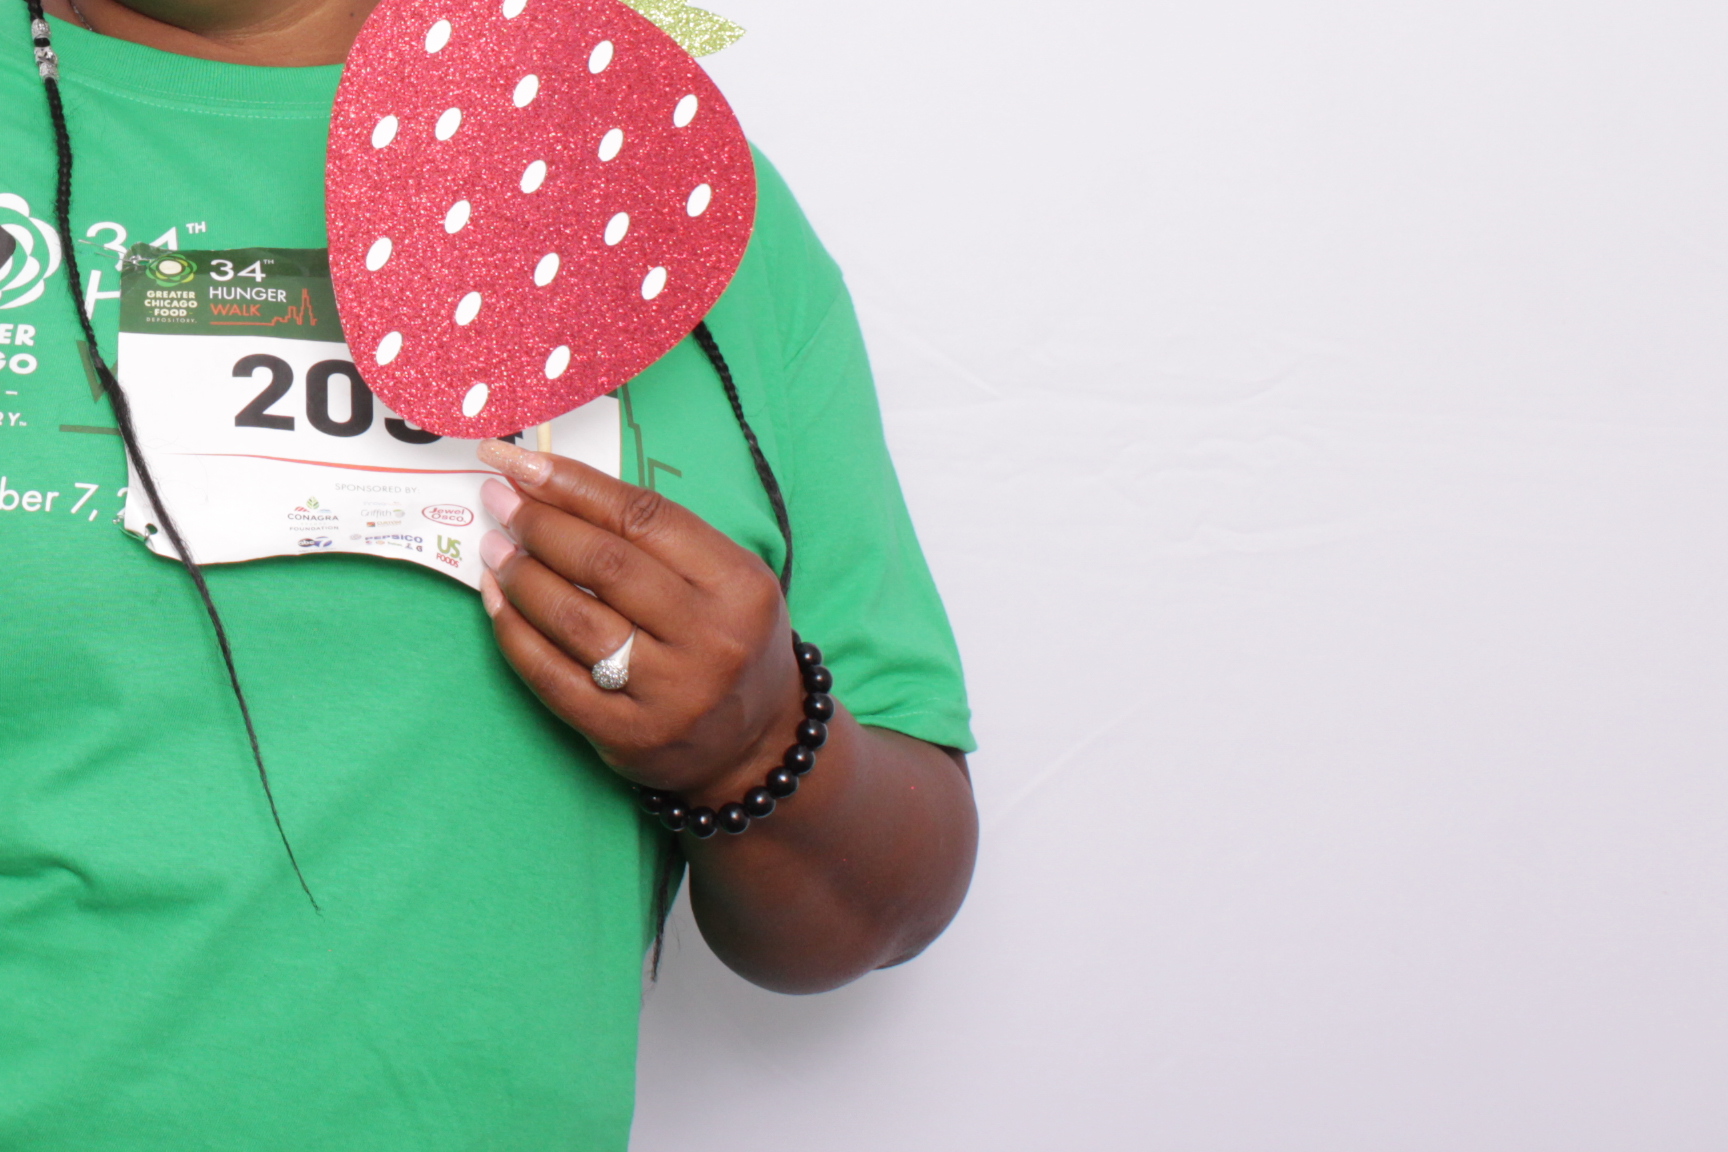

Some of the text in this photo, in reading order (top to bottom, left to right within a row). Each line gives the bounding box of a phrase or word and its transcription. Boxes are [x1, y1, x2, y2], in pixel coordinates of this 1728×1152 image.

[146, 290, 196, 299] GREATER
[209, 286, 287, 303] HUNGER
[144, 299, 198, 308] CHICAGO
[210, 303, 261, 316] WALK
[334, 483, 402, 494] SPONSORED
[70, 482, 100, 522] 7,
[287, 512, 339, 521] CONAGRA
[429, 507, 466, 515] Jewel
[436, 552, 460, 568] FOODS
